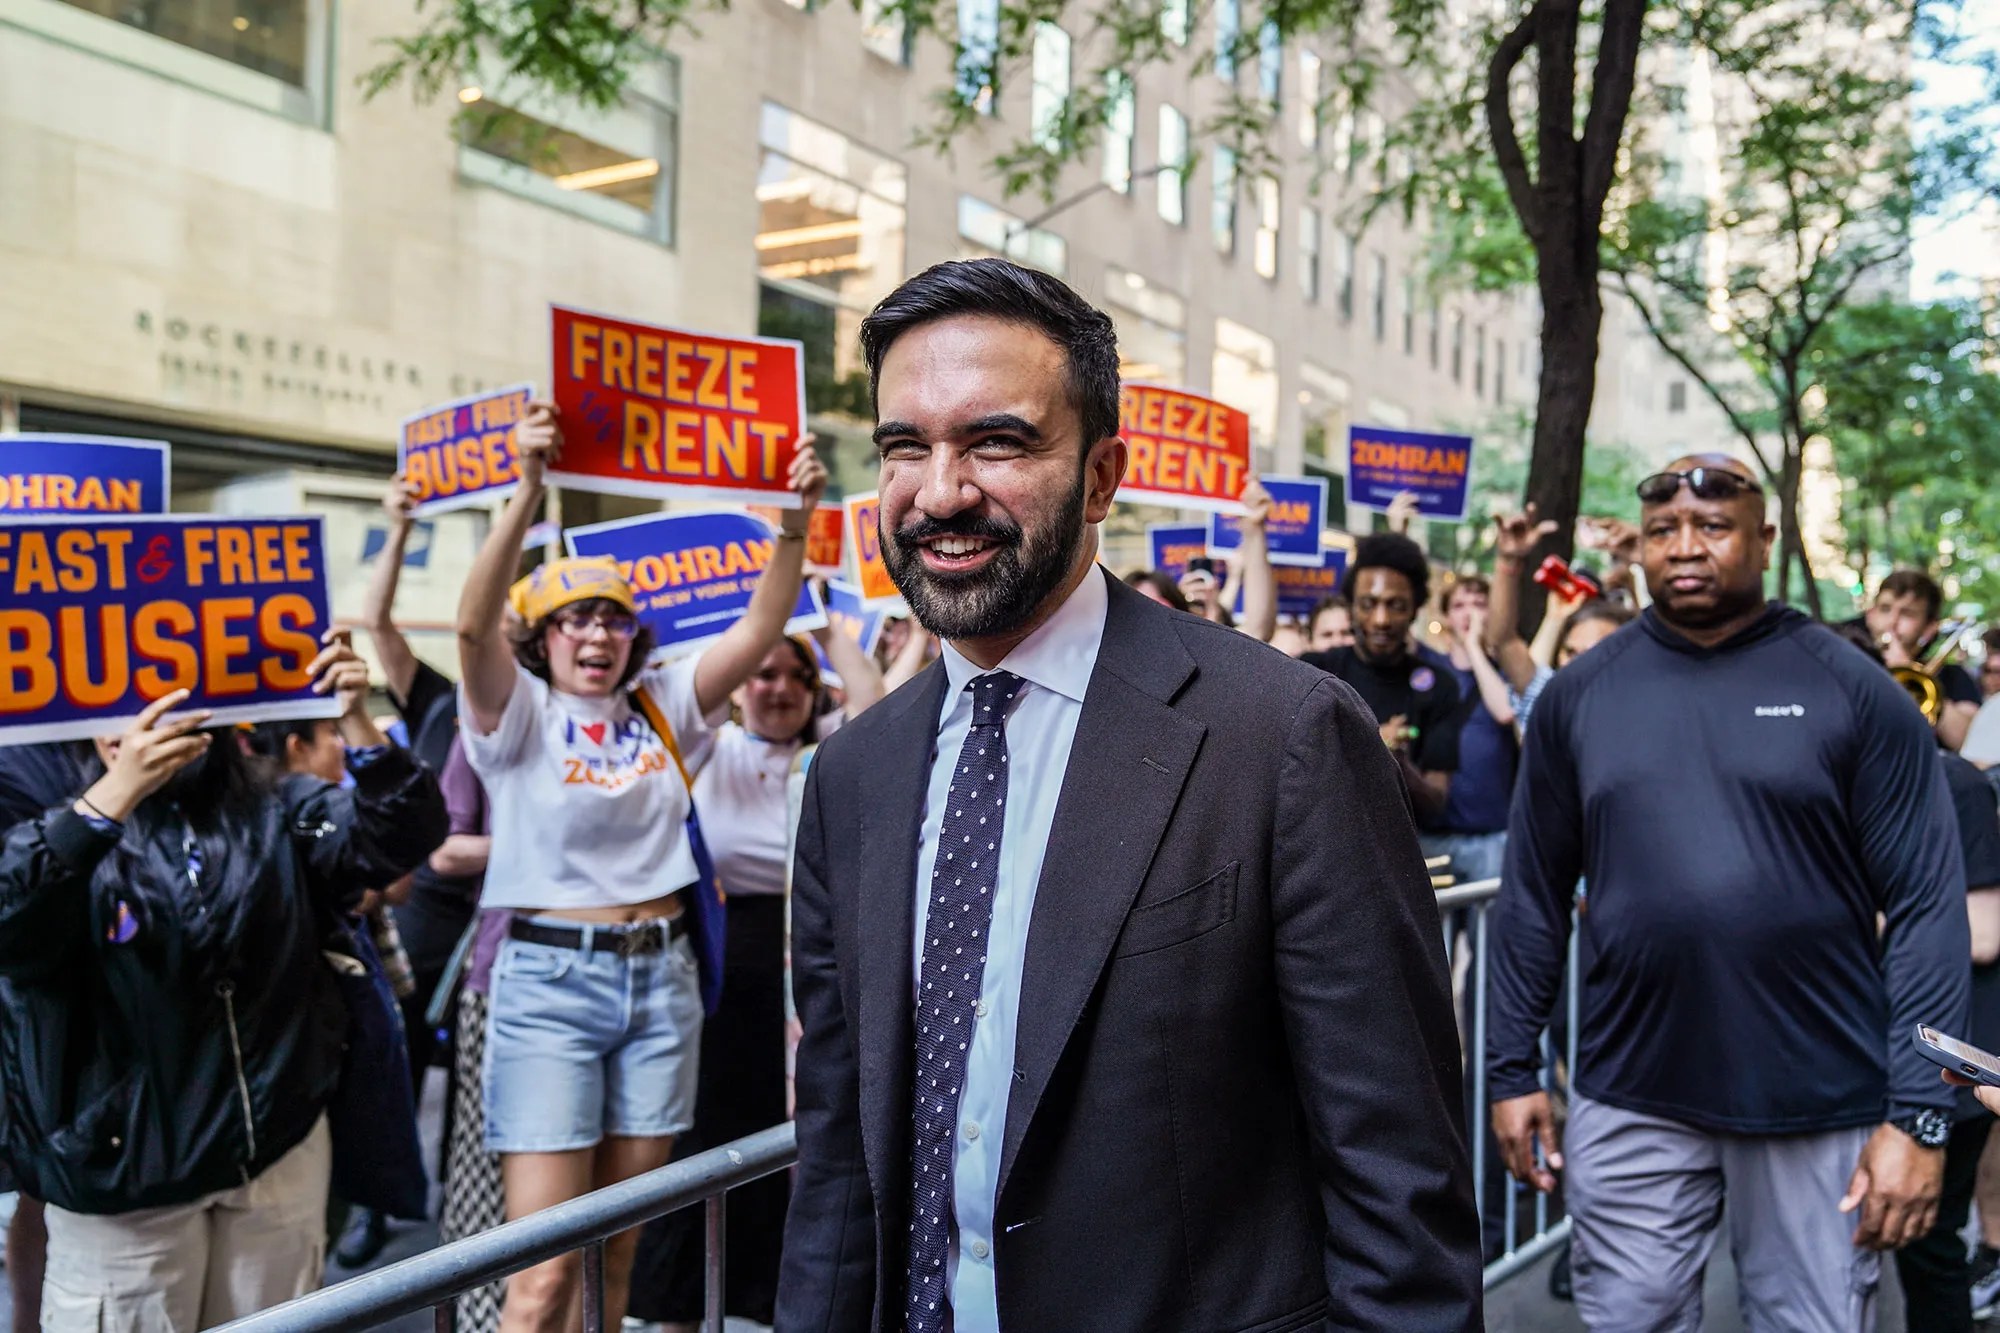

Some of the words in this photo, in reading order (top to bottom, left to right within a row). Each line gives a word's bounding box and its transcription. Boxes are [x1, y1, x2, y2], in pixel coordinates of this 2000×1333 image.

[570, 319, 760, 414] FREEZE
[621, 400, 789, 482] RENT
[1119, 390, 1229, 450] REEZE
[1125, 436, 1246, 496] RENT
[1352, 439, 1467, 477] ZOHRAN
[136, 534, 174, 583] &
[183, 526, 314, 586] FREE
[0, 593, 318, 713] BUSES
